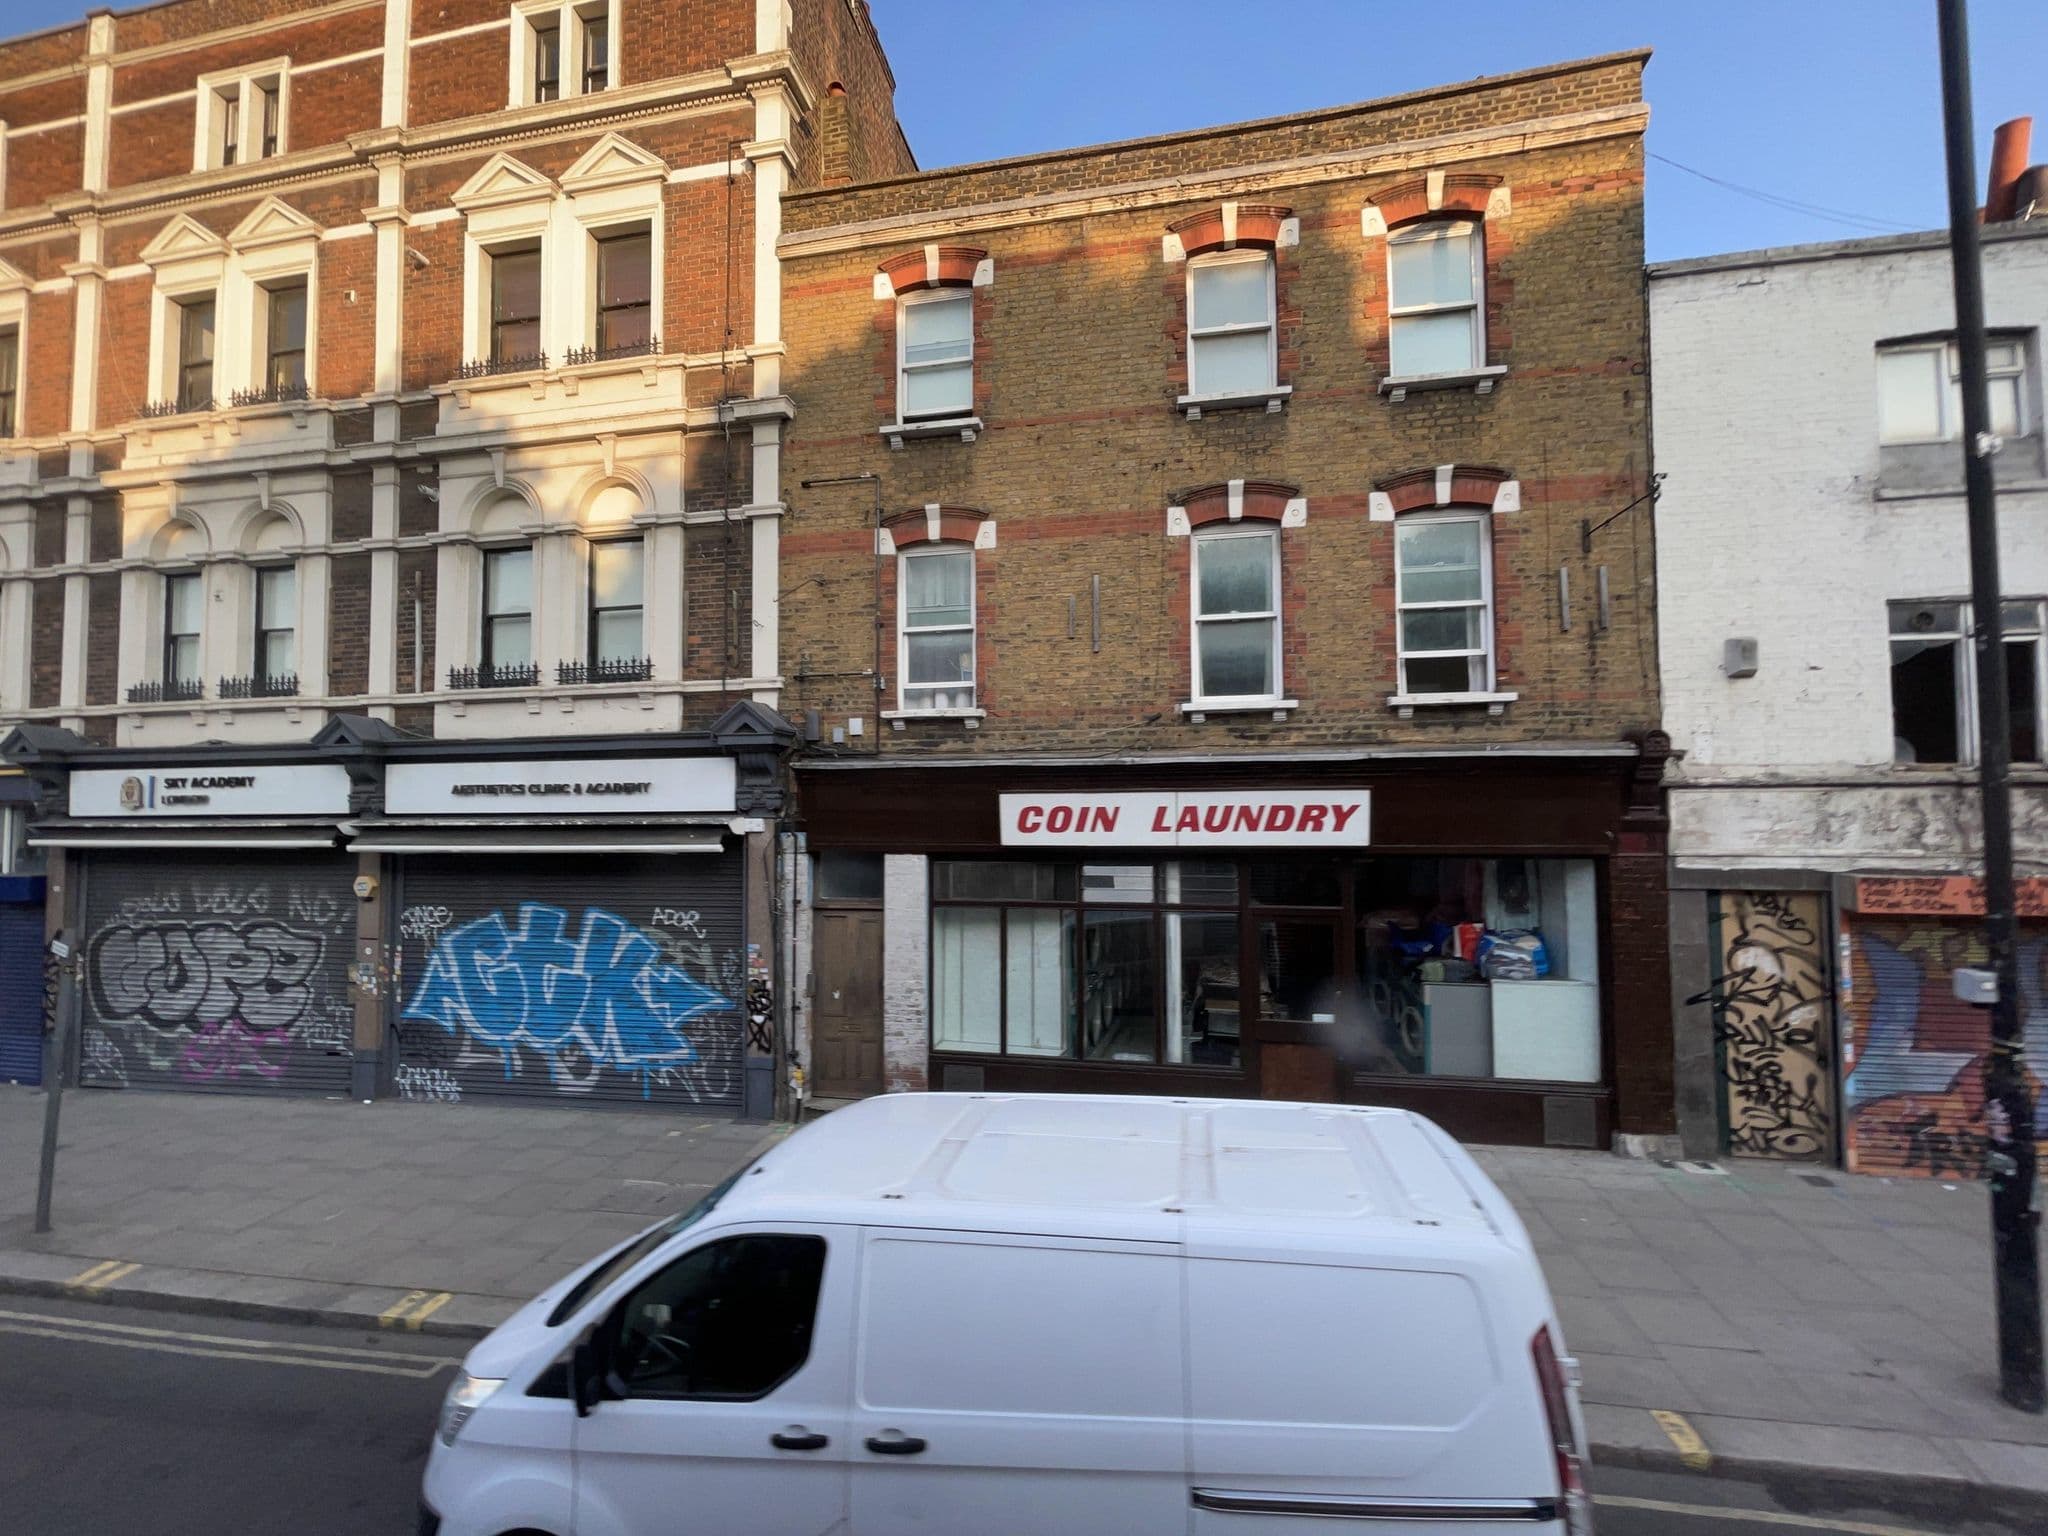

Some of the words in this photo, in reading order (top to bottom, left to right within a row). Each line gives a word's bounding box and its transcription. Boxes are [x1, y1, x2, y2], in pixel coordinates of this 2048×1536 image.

[164, 778, 188, 789] SKY
[191, 776, 255, 789] ACADEMY
[452, 784, 526, 796] AESTHETICS
[528, 784, 570, 795] CLINIC
[573, 783, 582, 795] &
[586, 782, 651, 795] ACADEMY
[1017, 806, 1120, 833] COIN
[1151, 805, 1360, 833] LAUNDRY
